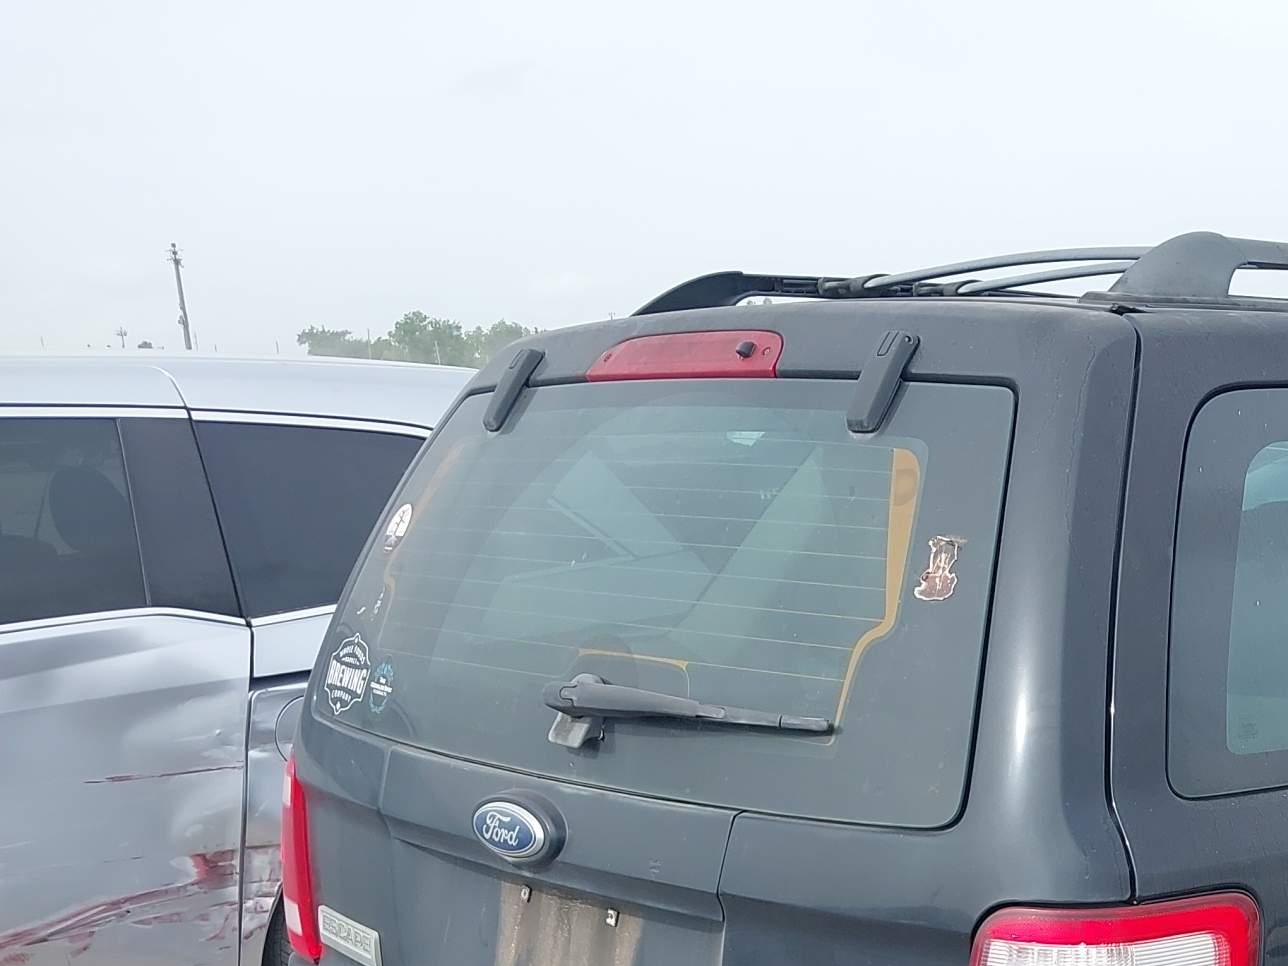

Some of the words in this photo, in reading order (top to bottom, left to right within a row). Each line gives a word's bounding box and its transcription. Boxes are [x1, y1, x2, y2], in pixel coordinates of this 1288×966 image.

[328, 659, 368, 695] BREWING
[331, 689, 352, 703] COMPANY
[482, 811, 521, 847] Ford
[322, 913, 372, 954] ESCAPE
